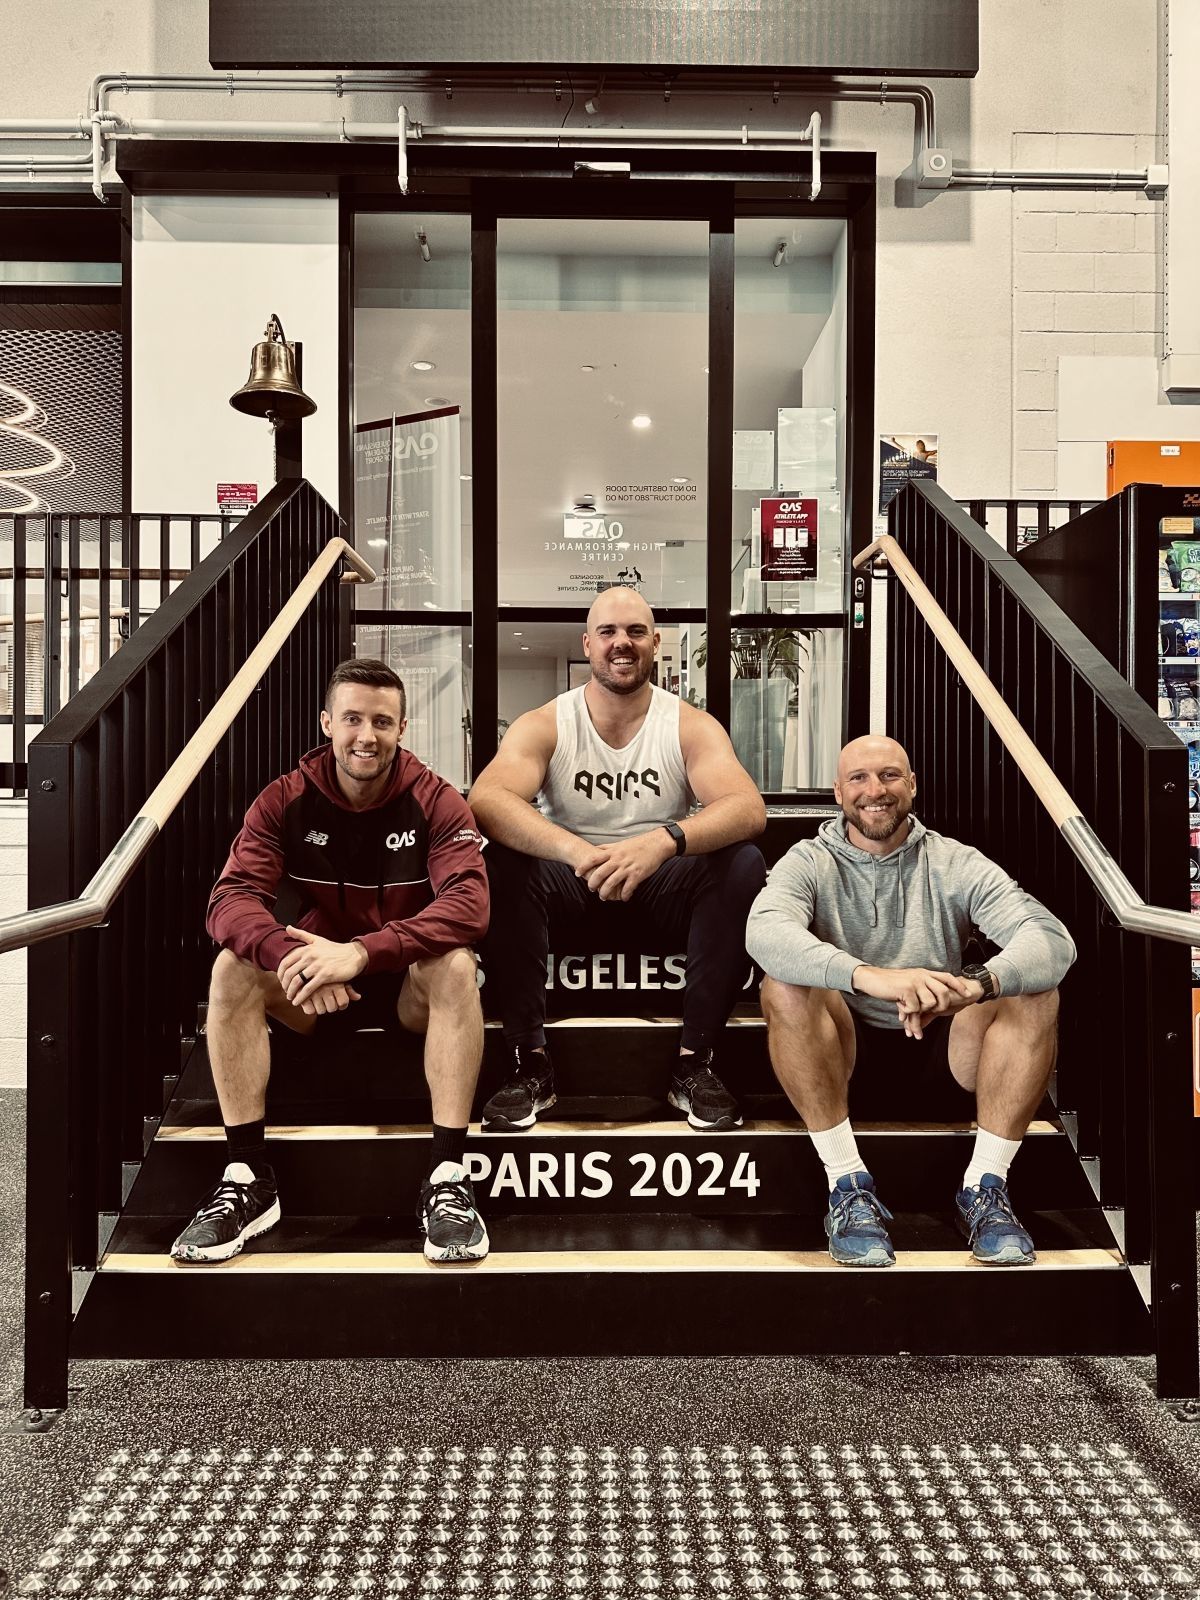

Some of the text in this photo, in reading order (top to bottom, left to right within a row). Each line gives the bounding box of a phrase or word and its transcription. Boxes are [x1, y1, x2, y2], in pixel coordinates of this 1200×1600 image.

[779, 502, 803, 513] QAS
[385, 829, 416, 851] QAS
[545, 953, 688, 990] GELES
[462, 1151, 761, 1199] PARIS 2024
